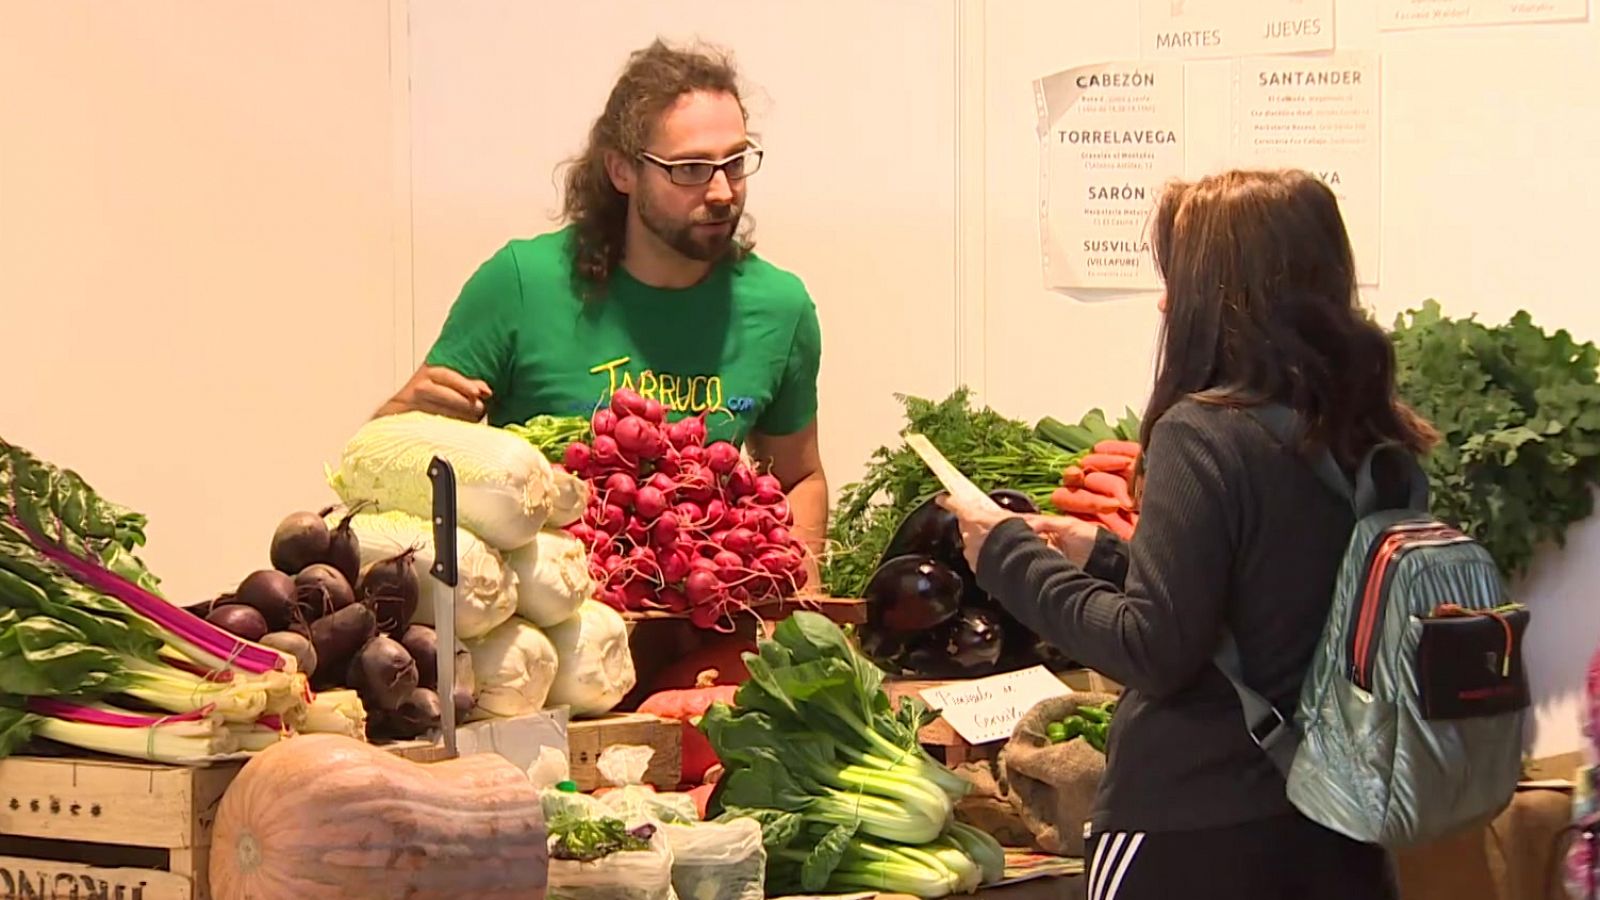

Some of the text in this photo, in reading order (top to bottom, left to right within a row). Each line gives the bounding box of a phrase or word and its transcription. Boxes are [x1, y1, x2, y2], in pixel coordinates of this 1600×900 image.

[1264, 18, 1321, 39] JUEVES
[1156, 29, 1221, 49] MARTES
[1076, 69, 1154, 88] CABEZÓN
[1259, 71, 1362, 86] SANTANDER
[1058, 130, 1176, 144] TORRELAVEGA
[1088, 183, 1145, 200] SARÓN
[1083, 240, 1150, 252] SUSVILLA
